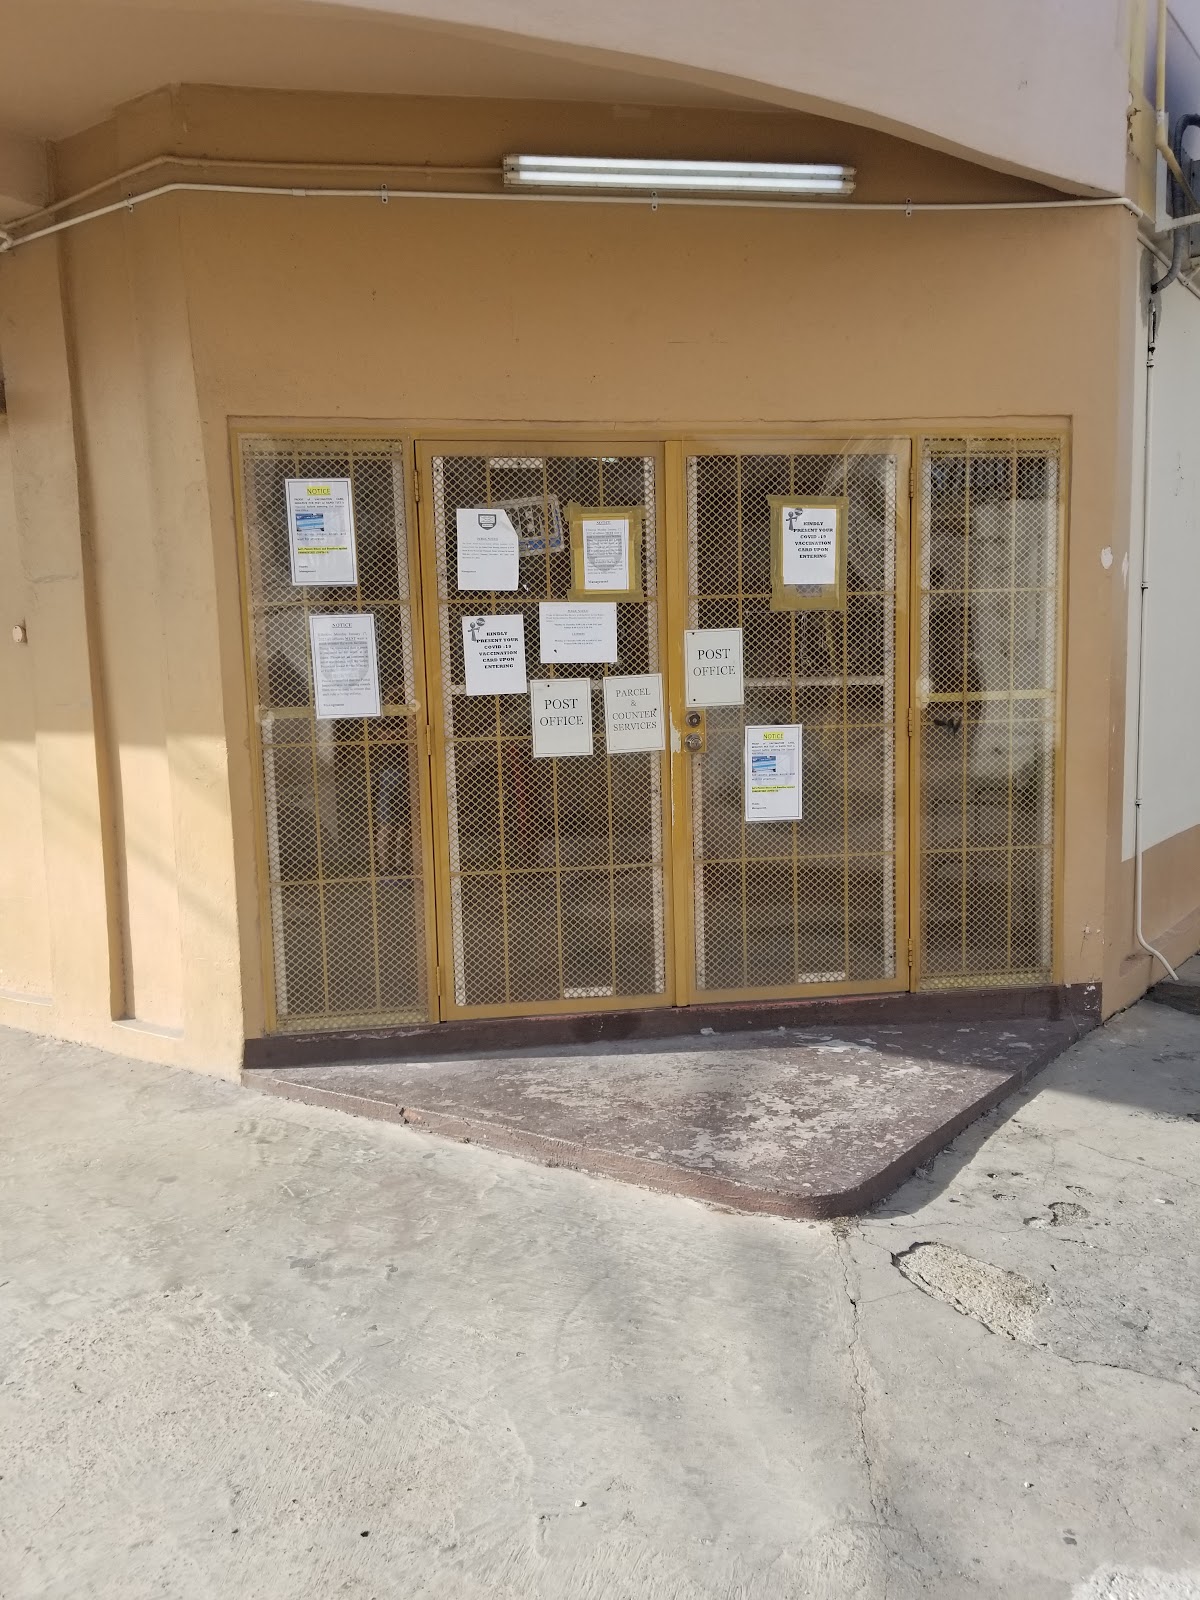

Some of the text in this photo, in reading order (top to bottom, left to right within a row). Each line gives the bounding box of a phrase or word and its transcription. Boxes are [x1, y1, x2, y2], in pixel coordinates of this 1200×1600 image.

[697, 648, 731, 660] POST
[693, 665, 736, 677] OFFICE
[615, 688, 651, 698] PARCEL
[544, 698, 579, 710] POST
[540, 715, 584, 727] OFFICE
[612, 710, 657, 721] COUNTER
[613, 721, 657, 732] SERVICES
